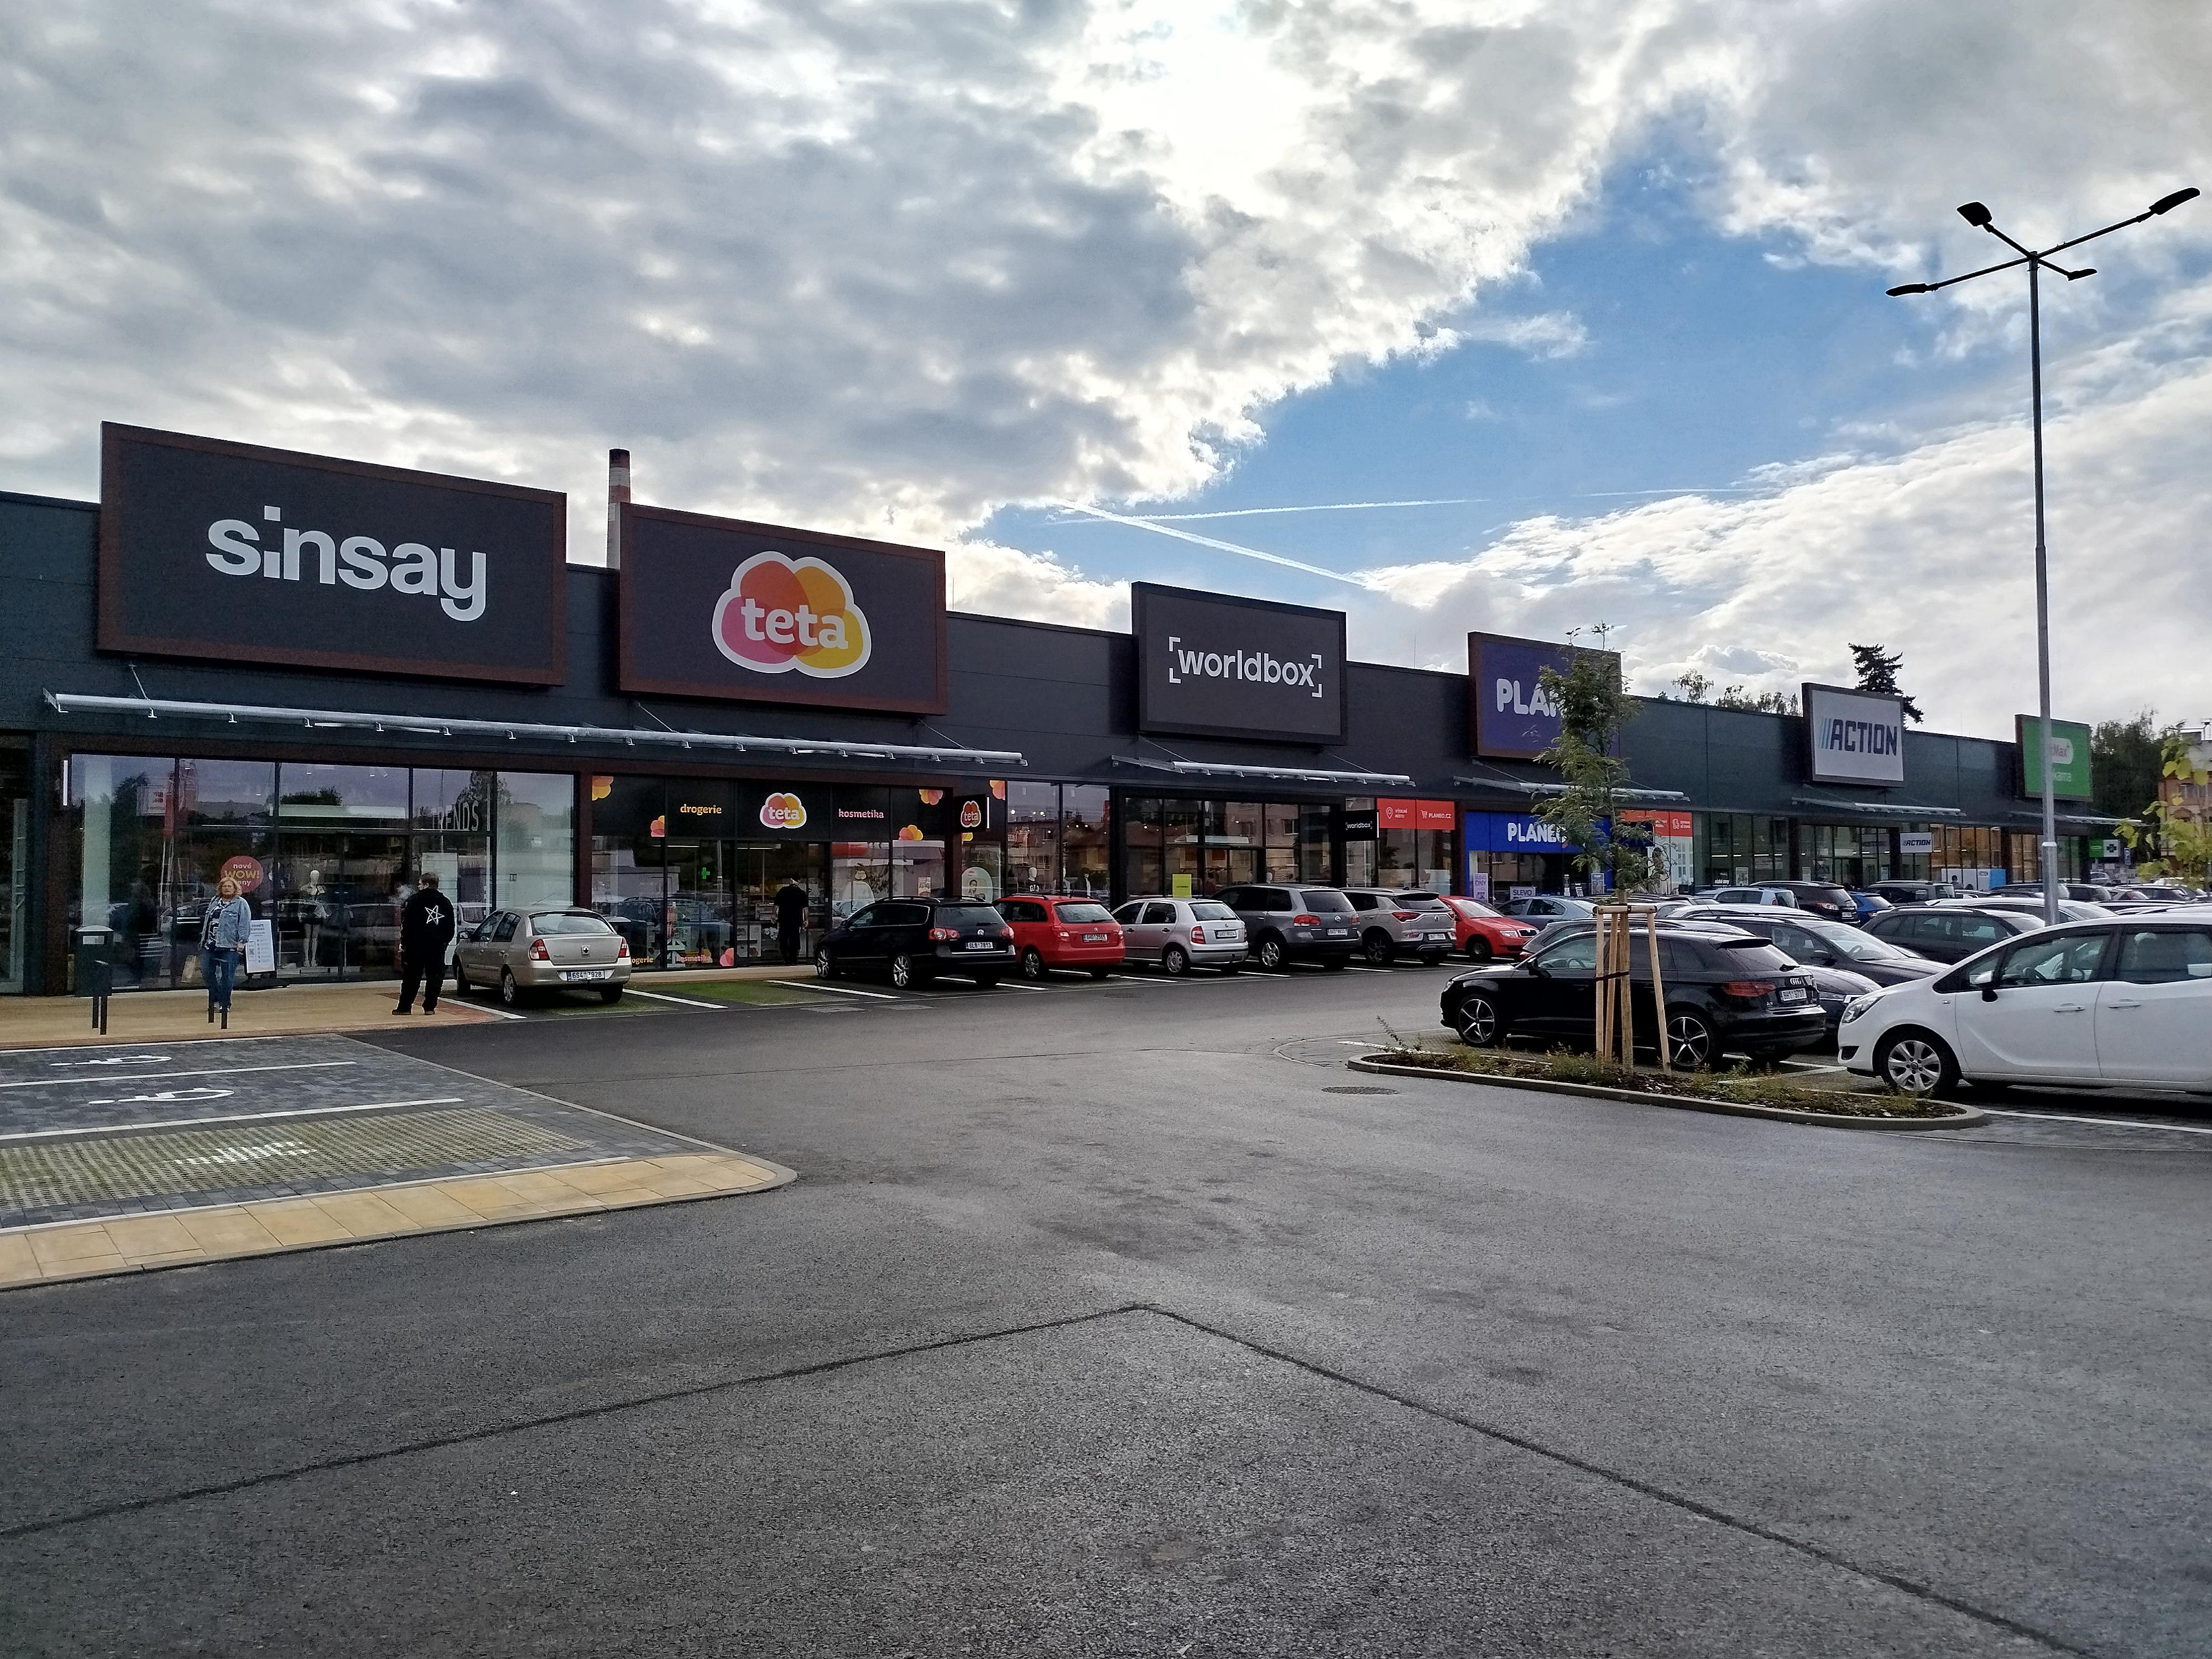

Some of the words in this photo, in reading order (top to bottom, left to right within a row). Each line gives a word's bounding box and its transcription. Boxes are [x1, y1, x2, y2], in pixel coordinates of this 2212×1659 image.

[206, 505, 487, 622] sinsay
[741, 598, 848, 650] teta
[1177, 649, 1314, 687] worldbox
[1829, 718, 1897, 756] ACTION
[680, 804, 722, 816] drogerie
[768, 807, 799, 820] teta
[838, 808, 884, 818] kosmetika
[963, 812, 979, 821] teta
[225, 870, 260, 879] WOW!
